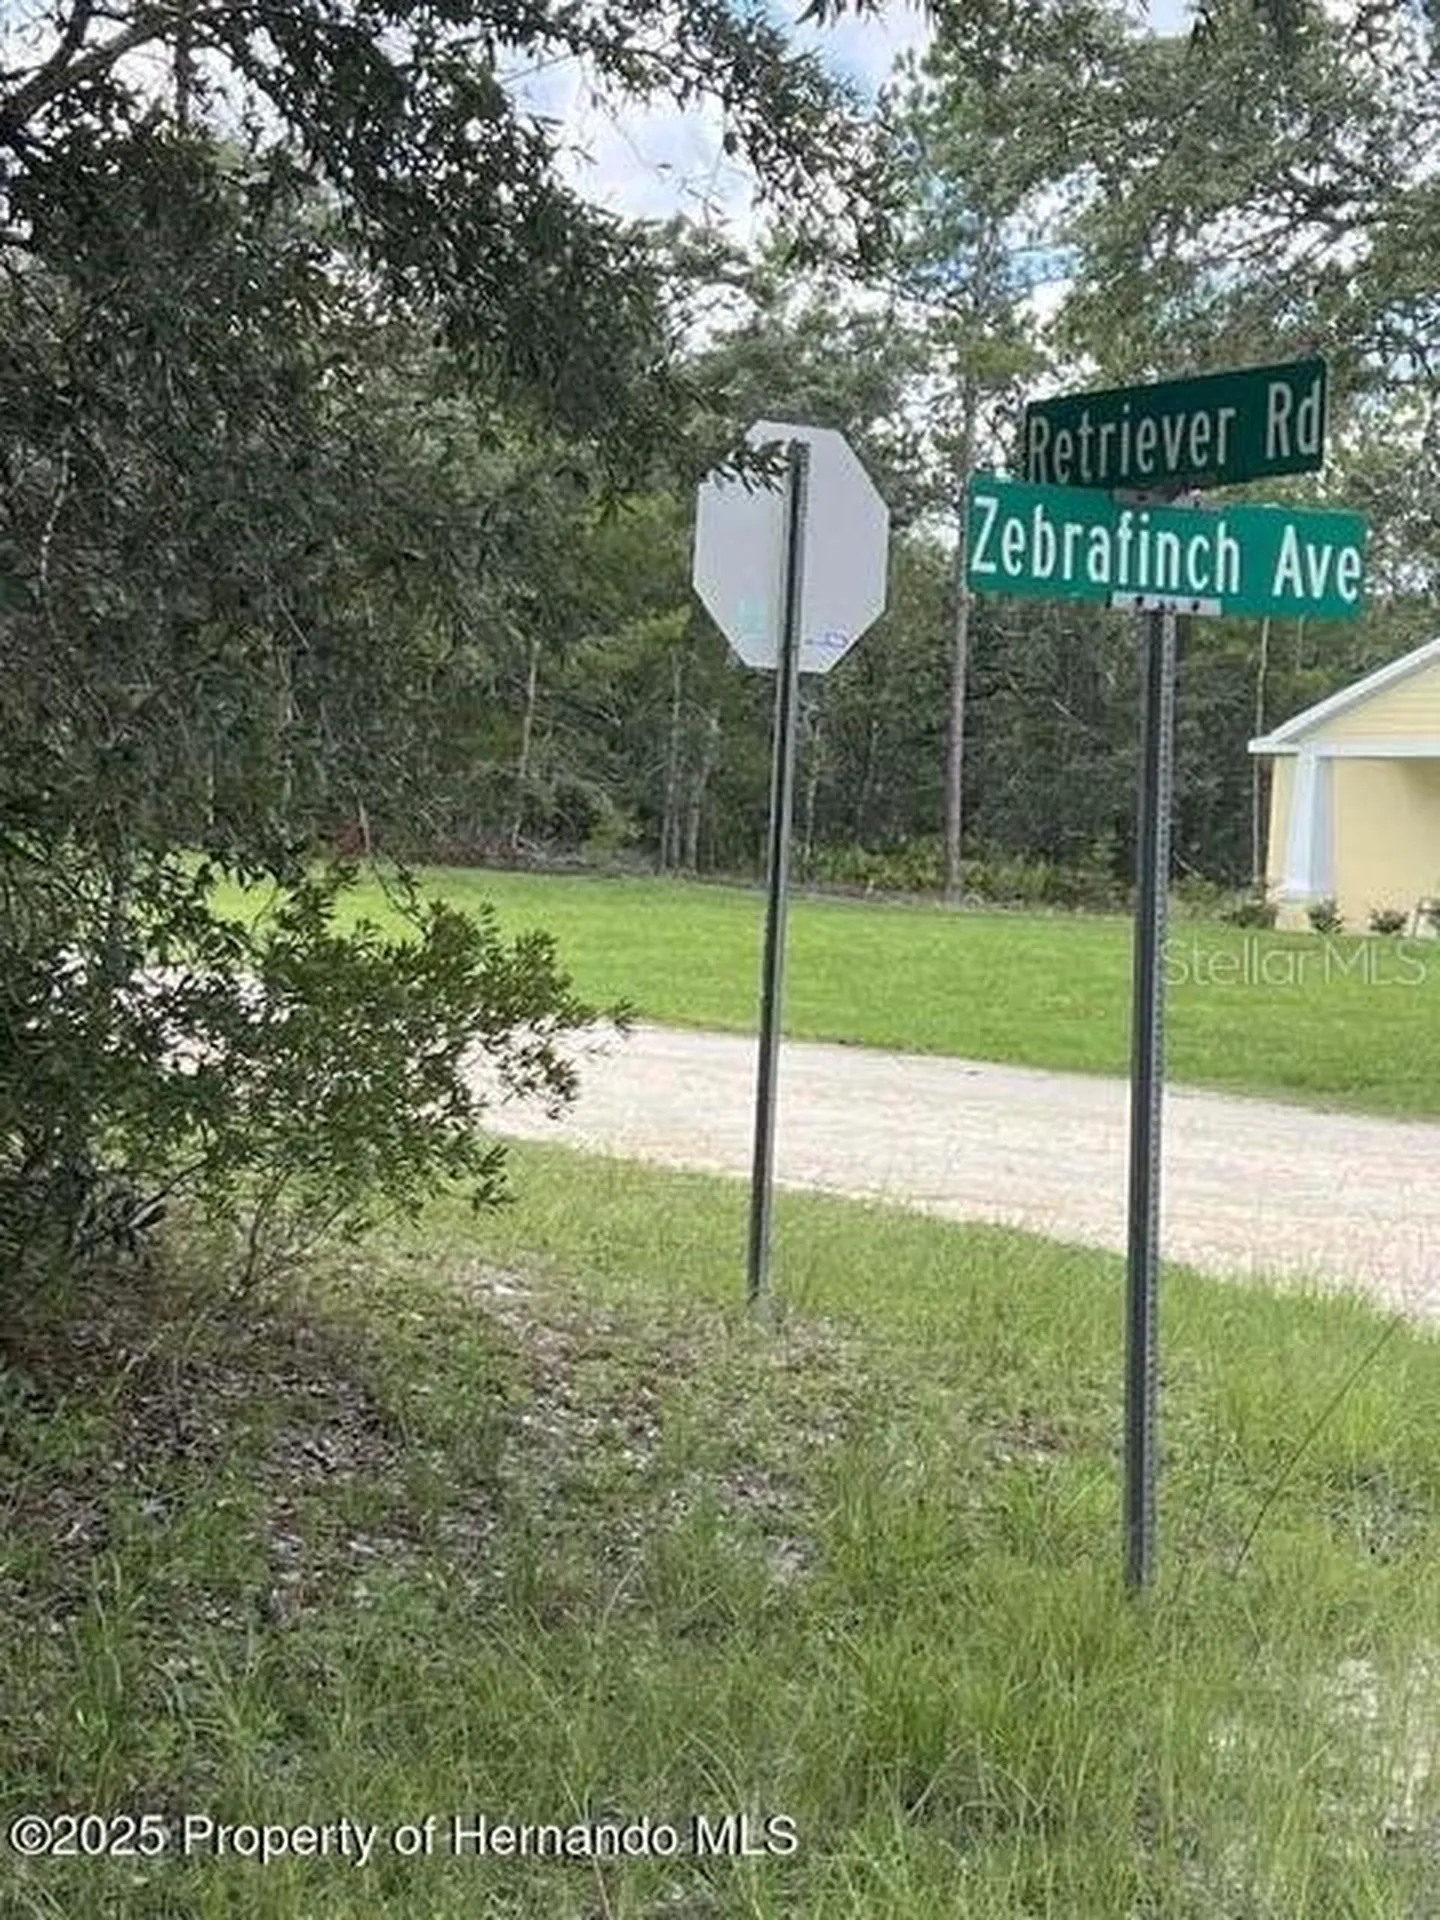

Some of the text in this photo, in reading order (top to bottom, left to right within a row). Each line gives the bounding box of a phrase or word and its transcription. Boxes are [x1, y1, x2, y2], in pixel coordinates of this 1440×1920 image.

[1028, 377, 1321, 484] Retriever Rd
[970, 496, 1362, 602] Zebrafinch Ave
